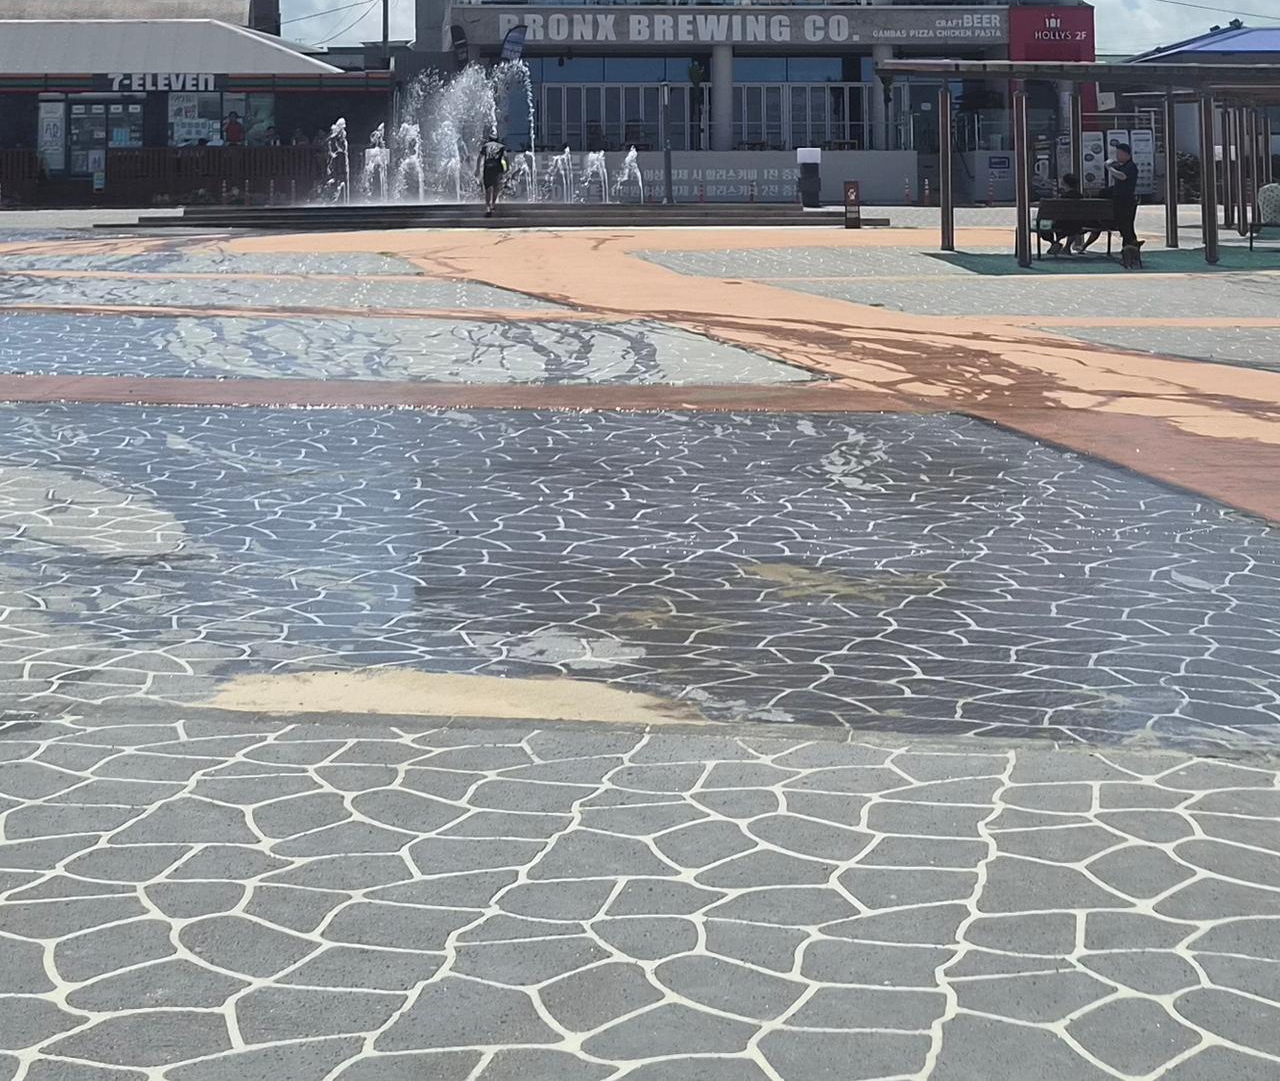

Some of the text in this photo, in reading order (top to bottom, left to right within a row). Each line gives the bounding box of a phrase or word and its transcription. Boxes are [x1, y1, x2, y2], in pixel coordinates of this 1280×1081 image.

[963, 14, 1001, 28] BEER
[629, 14, 792, 42] BREWING
[804, 14, 860, 42] CO.
[909, 29, 935, 38] PIZZA
[936, 29, 972, 38] CHICKEN
[974, 29, 1002, 38] PASTA
[1034, 31, 1088, 40] HOLLYS 2F
